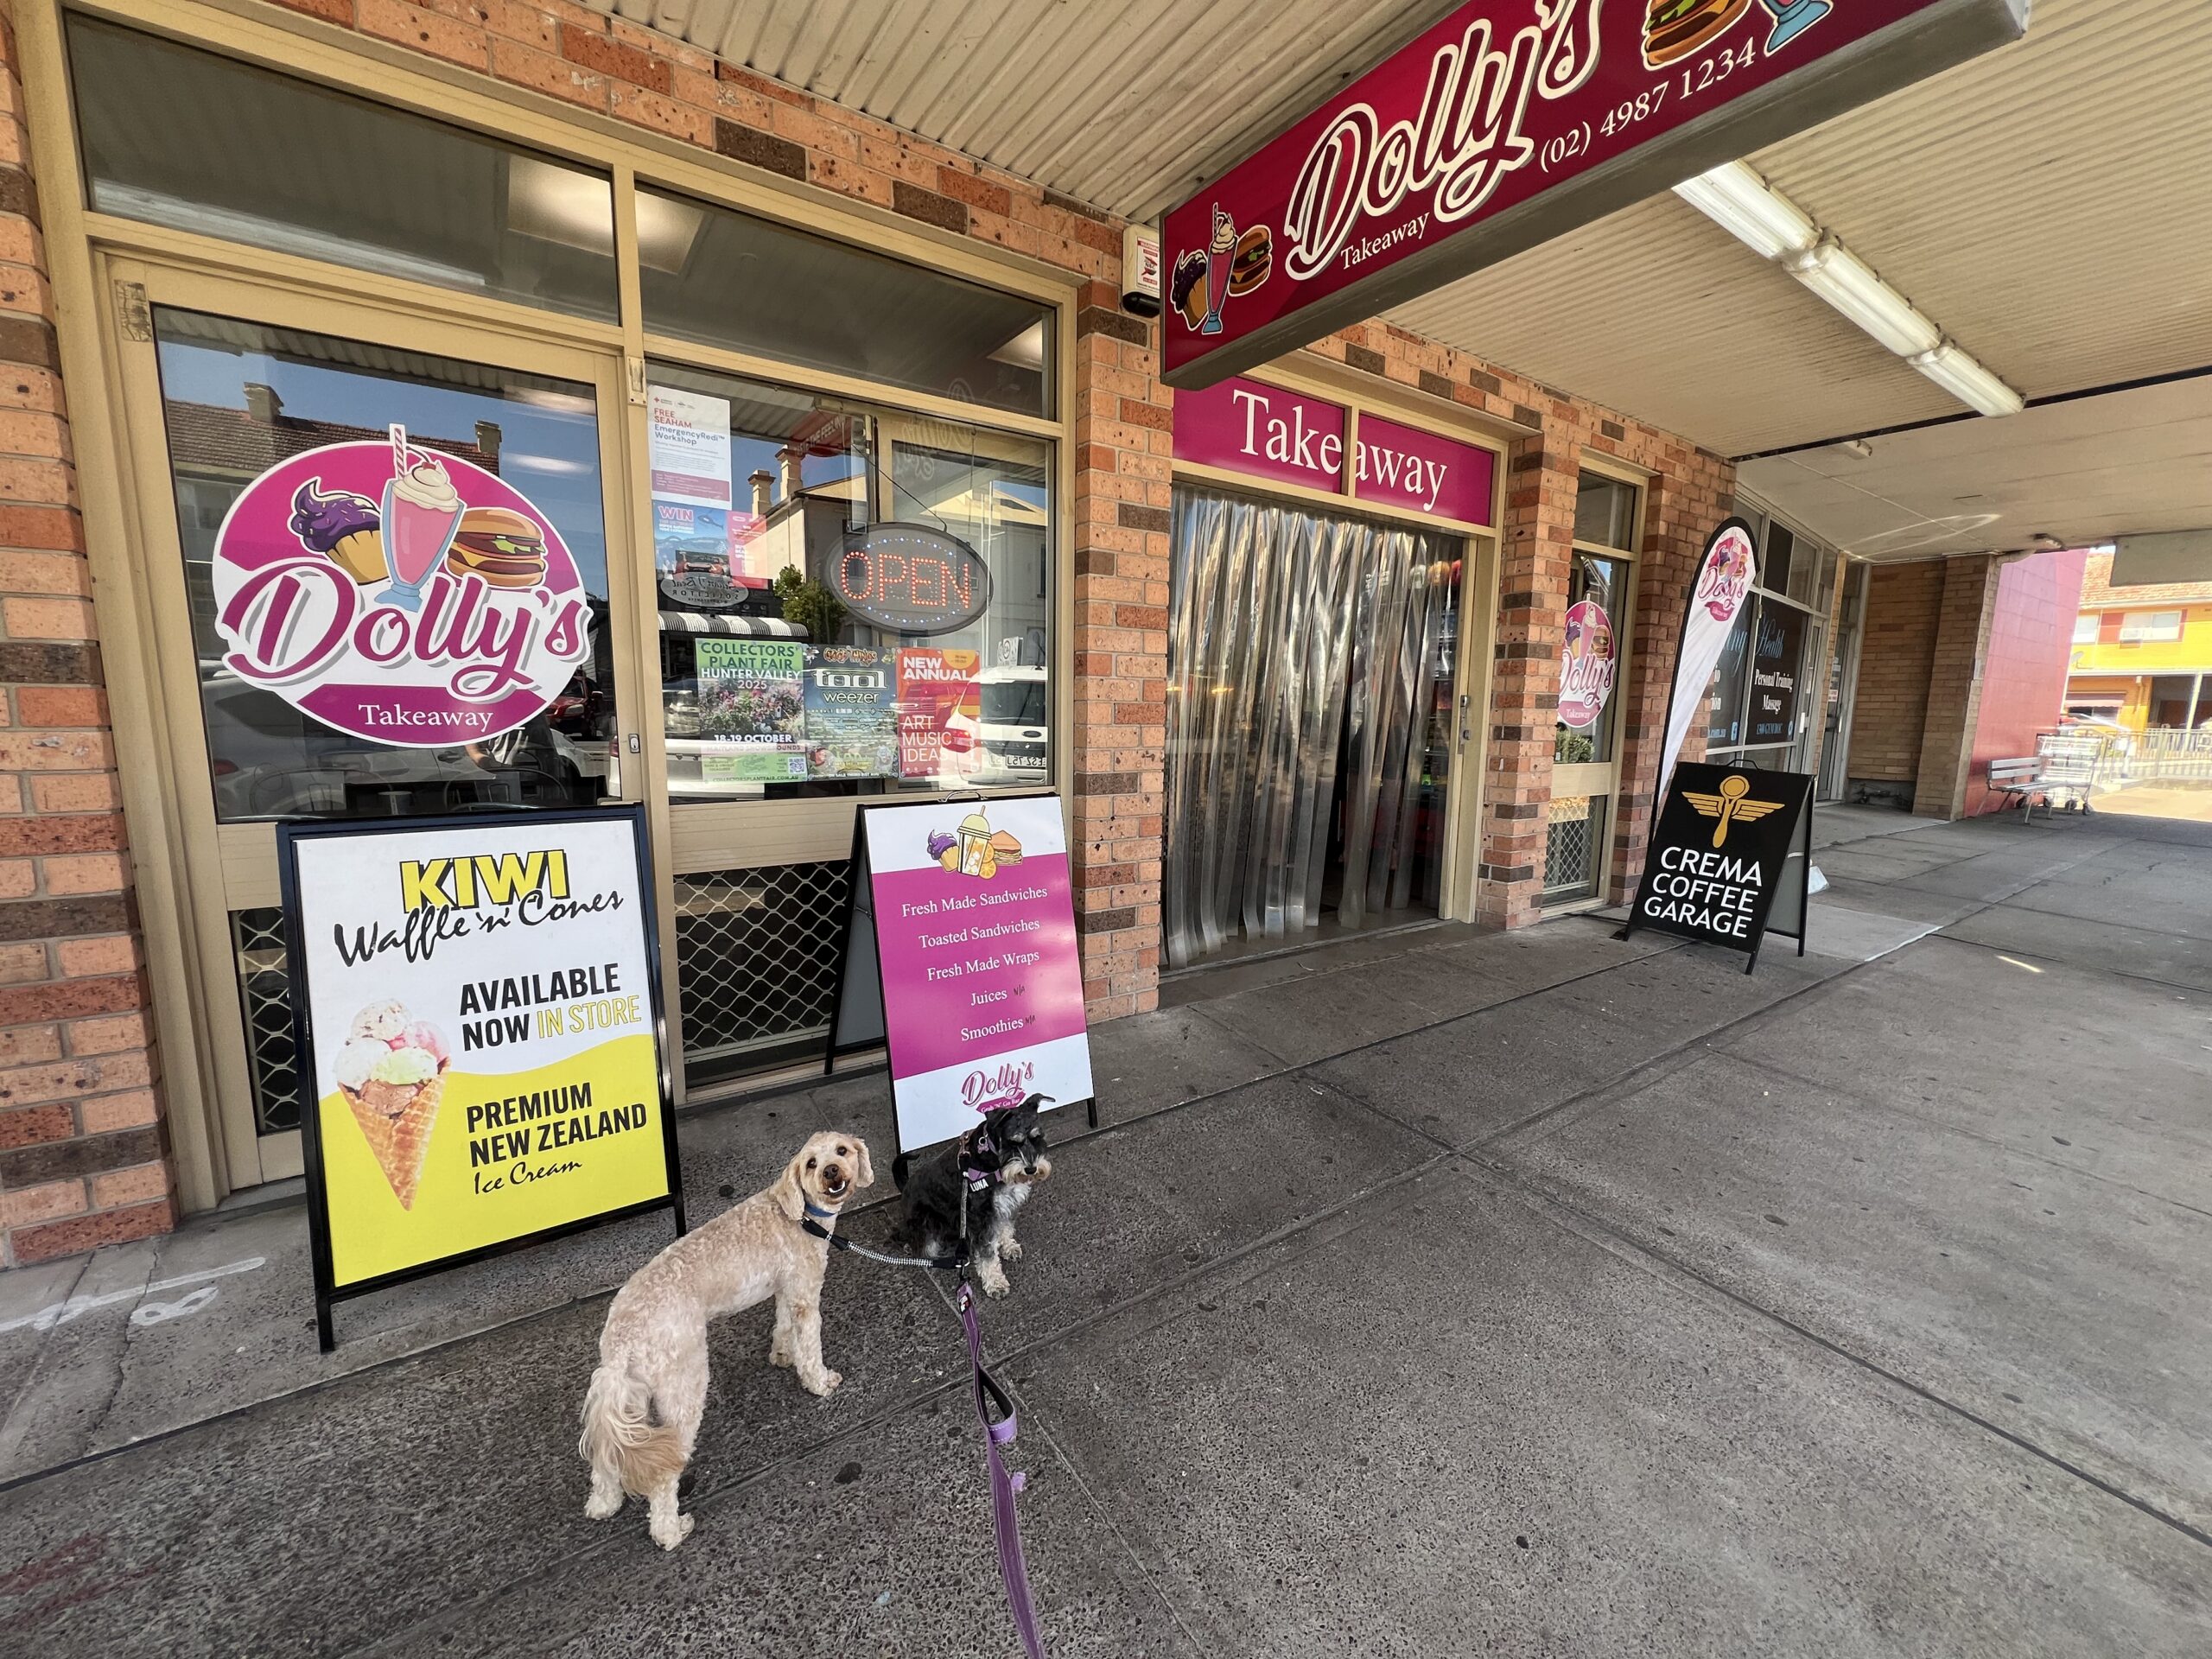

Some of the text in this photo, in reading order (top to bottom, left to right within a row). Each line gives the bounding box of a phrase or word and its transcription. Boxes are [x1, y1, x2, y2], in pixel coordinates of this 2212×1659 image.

[1541, 36, 1757, 173] (02) 4987 1234
[1284, 0, 1599, 280] Dolly's
[1340, 212, 1431, 270] Takeaway
[653, 407, 676, 418] FREE
[654, 416, 692, 429] SEAHAM
[654, 431, 697, 446] Workshop
[1232, 389, 1448, 512] Takeaway
[658, 505, 694, 523] WIN
[841, 550, 972, 609] OPEN
[222, 562, 583, 696] Dolly's
[701, 642, 798, 657] COLLECTORS'
[701, 668, 802, 680] HUNTER VALLEY
[709, 656, 793, 670] PLANT FAIR
[903, 657, 942, 669] NEW
[903, 669, 972, 681] ANNUAL
[737, 680, 767, 690] 2025
[1754, 669, 1794, 693] Personal Training
[823, 692, 880, 704] weezer
[1762, 694, 1782, 715] Massage
[358, 703, 494, 733] Takeaway
[902, 716, 935, 730] ART
[1566, 709, 1591, 720] Takeaway
[714, 734, 793, 743] 18-19 OCTOBER
[901, 732, 952, 747] MUSIC
[902, 748, 949, 763] IDEAS
[1661, 846, 1763, 887] CREMA
[399, 849, 571, 914] KIWI
[1652, 873, 1759, 913] COFFEE
[902, 887, 1048, 918] Fresh Made Sandwiches
[334, 905, 471, 967] Waffle
[518, 890, 624, 926] Cones
[1643, 896, 1752, 938] GARAGE
[918, 918, 1040, 948] Toasted Sandwiches
[927, 951, 1040, 981] Fresh Made Wraps
[460, 963, 621, 1016] AVAILABLE
[970, 989, 1008, 1006] Juices
[1014, 984, 1026, 995] N/A
[461, 995, 642, 1052] NOW IN STORE
[960, 1017, 1024, 1041] Smoothies
[961, 1061, 1034, 1106] Dolly's
[467, 1082, 593, 1134] PREMIUM
[469, 1103, 647, 1168] NEW ZEALAND
[474, 1161, 582, 1195] Ice Cream
[969, 1178, 989, 1192] LUNA
